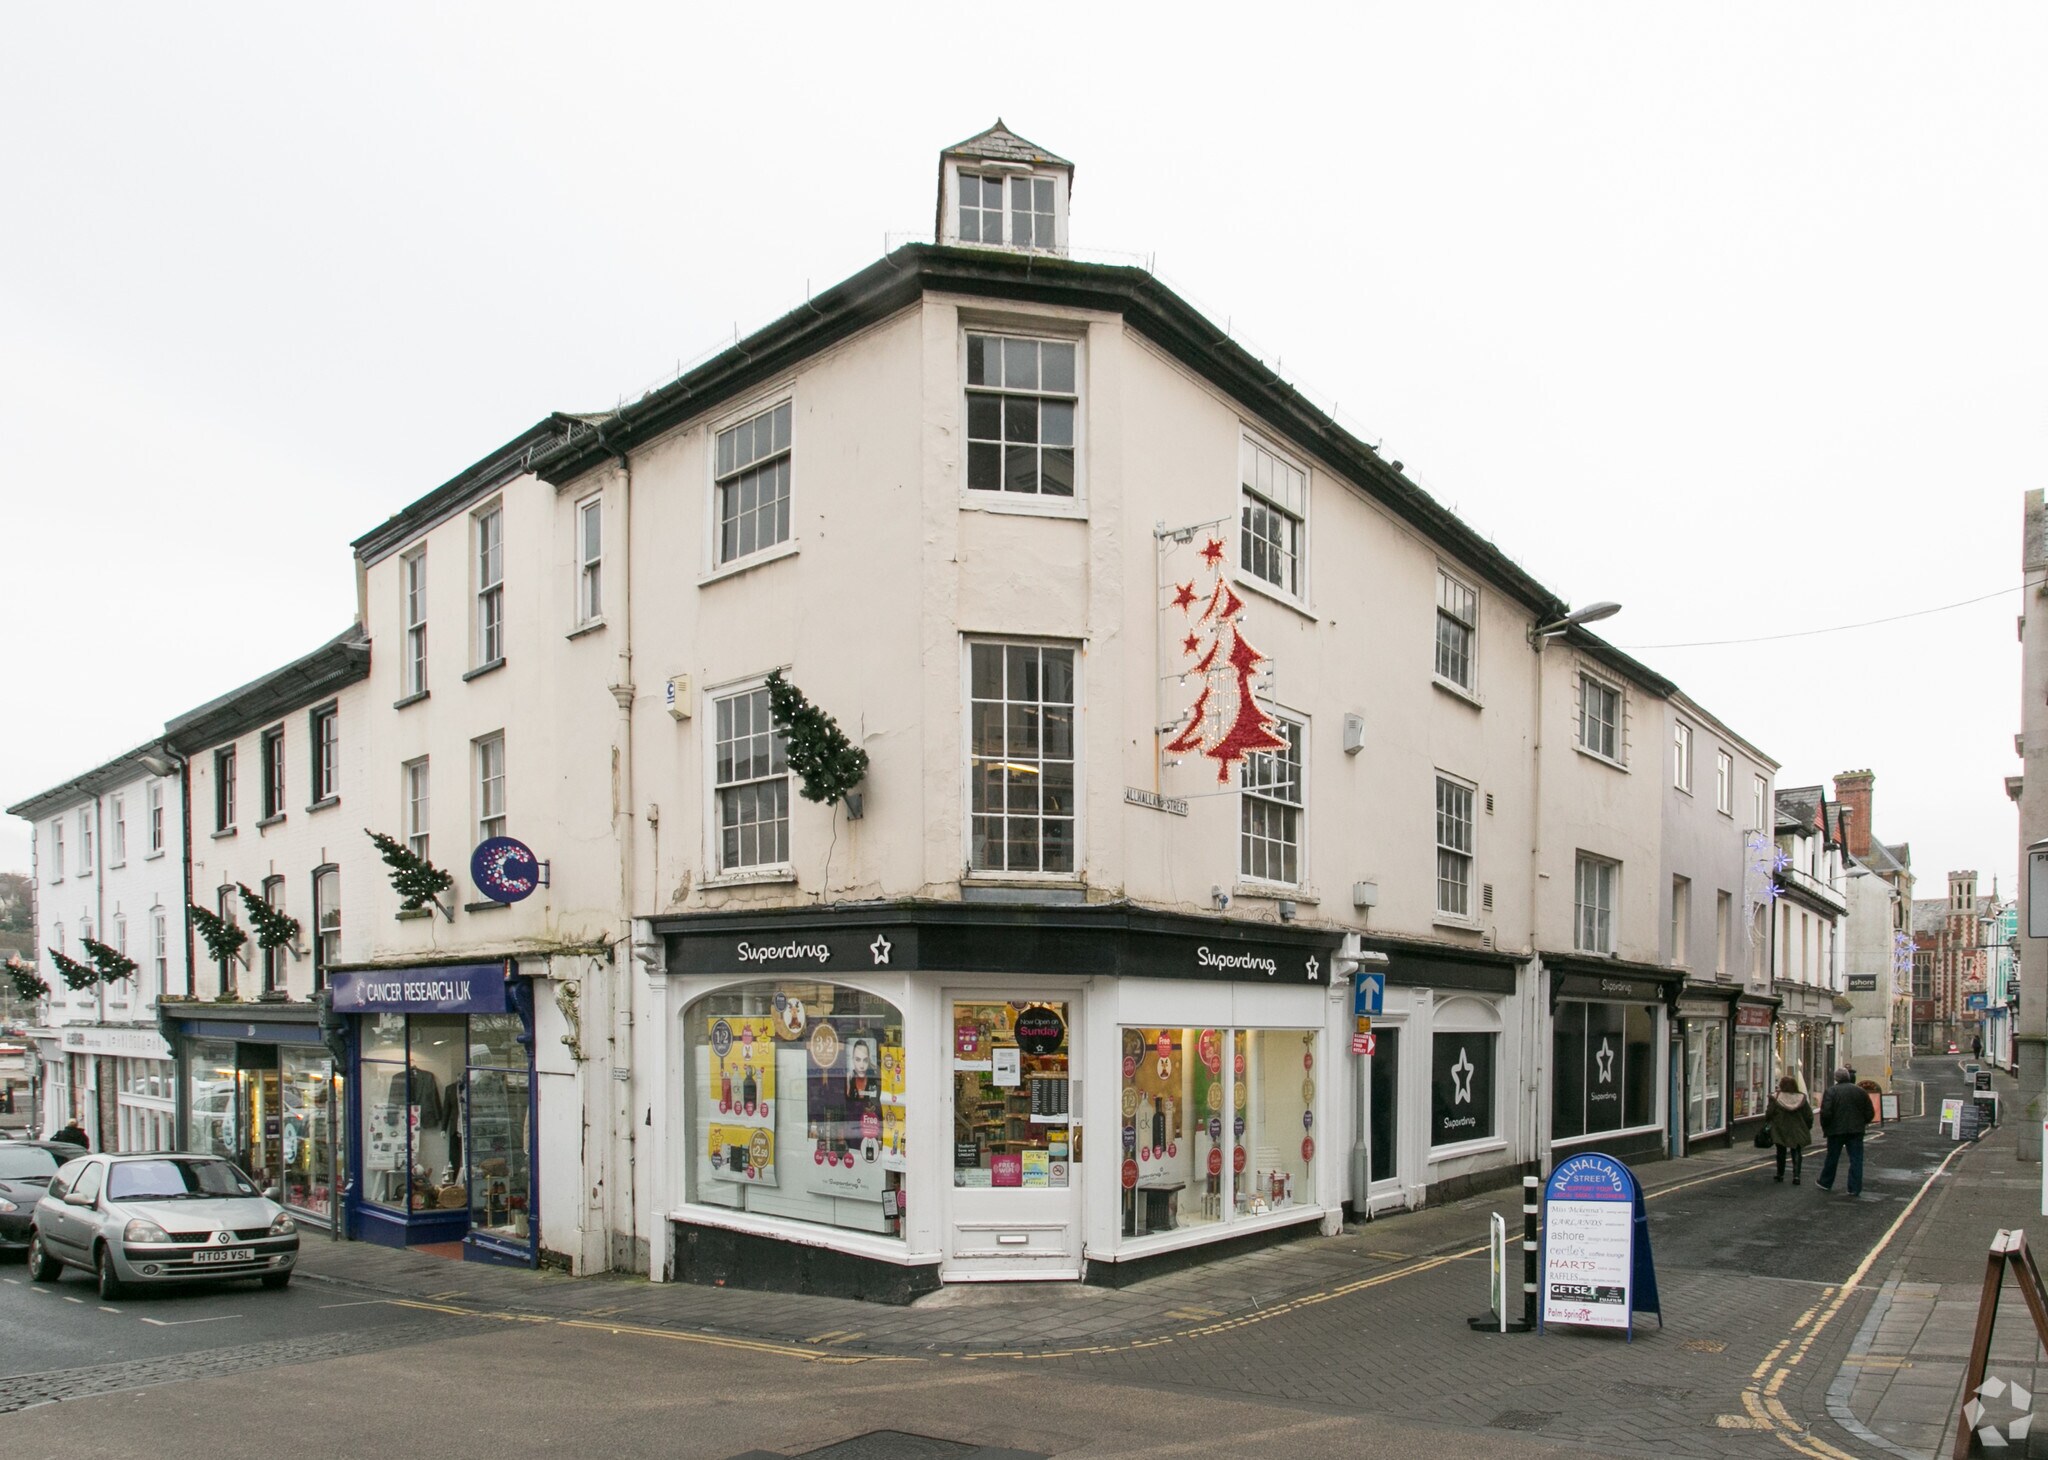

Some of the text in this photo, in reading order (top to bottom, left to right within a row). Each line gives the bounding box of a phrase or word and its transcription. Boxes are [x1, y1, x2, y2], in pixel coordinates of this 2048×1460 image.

[1167, 800, 1186, 813] STREET
[738, 941, 830, 964] Superdrug
[1198, 947, 1276, 976] Superdrug
[367, 980, 471, 1002] CANCER RESEARCH UK
[1602, 979, 1632, 994] Superdrug
[1020, 1026, 1059, 1038] Sunday
[1158, 1036, 1171, 1046] Free
[1590, 1091, 1617, 1101] Superdrug
[863, 1115, 878, 1125] Free
[1443, 1116, 1477, 1130] Superdrug
[1554, 1159, 1622, 1192] ALLHALLAND
[1573, 1175, 1606, 1183] STREET
[1551, 1218, 1603, 1227] GARLANDS
[1551, 1231, 1585, 1241] ashore
[198, 1250, 251, 1261] HT03 VSL
[1550, 1245, 1585, 1256] cecile's
[1549, 1259, 1596, 1270] HARTS
[1550, 1271, 1579, 1281] RAFFLES
[1548, 1307, 1562, 1318] Palm
[1564, 1308, 1586, 1321] Springs
